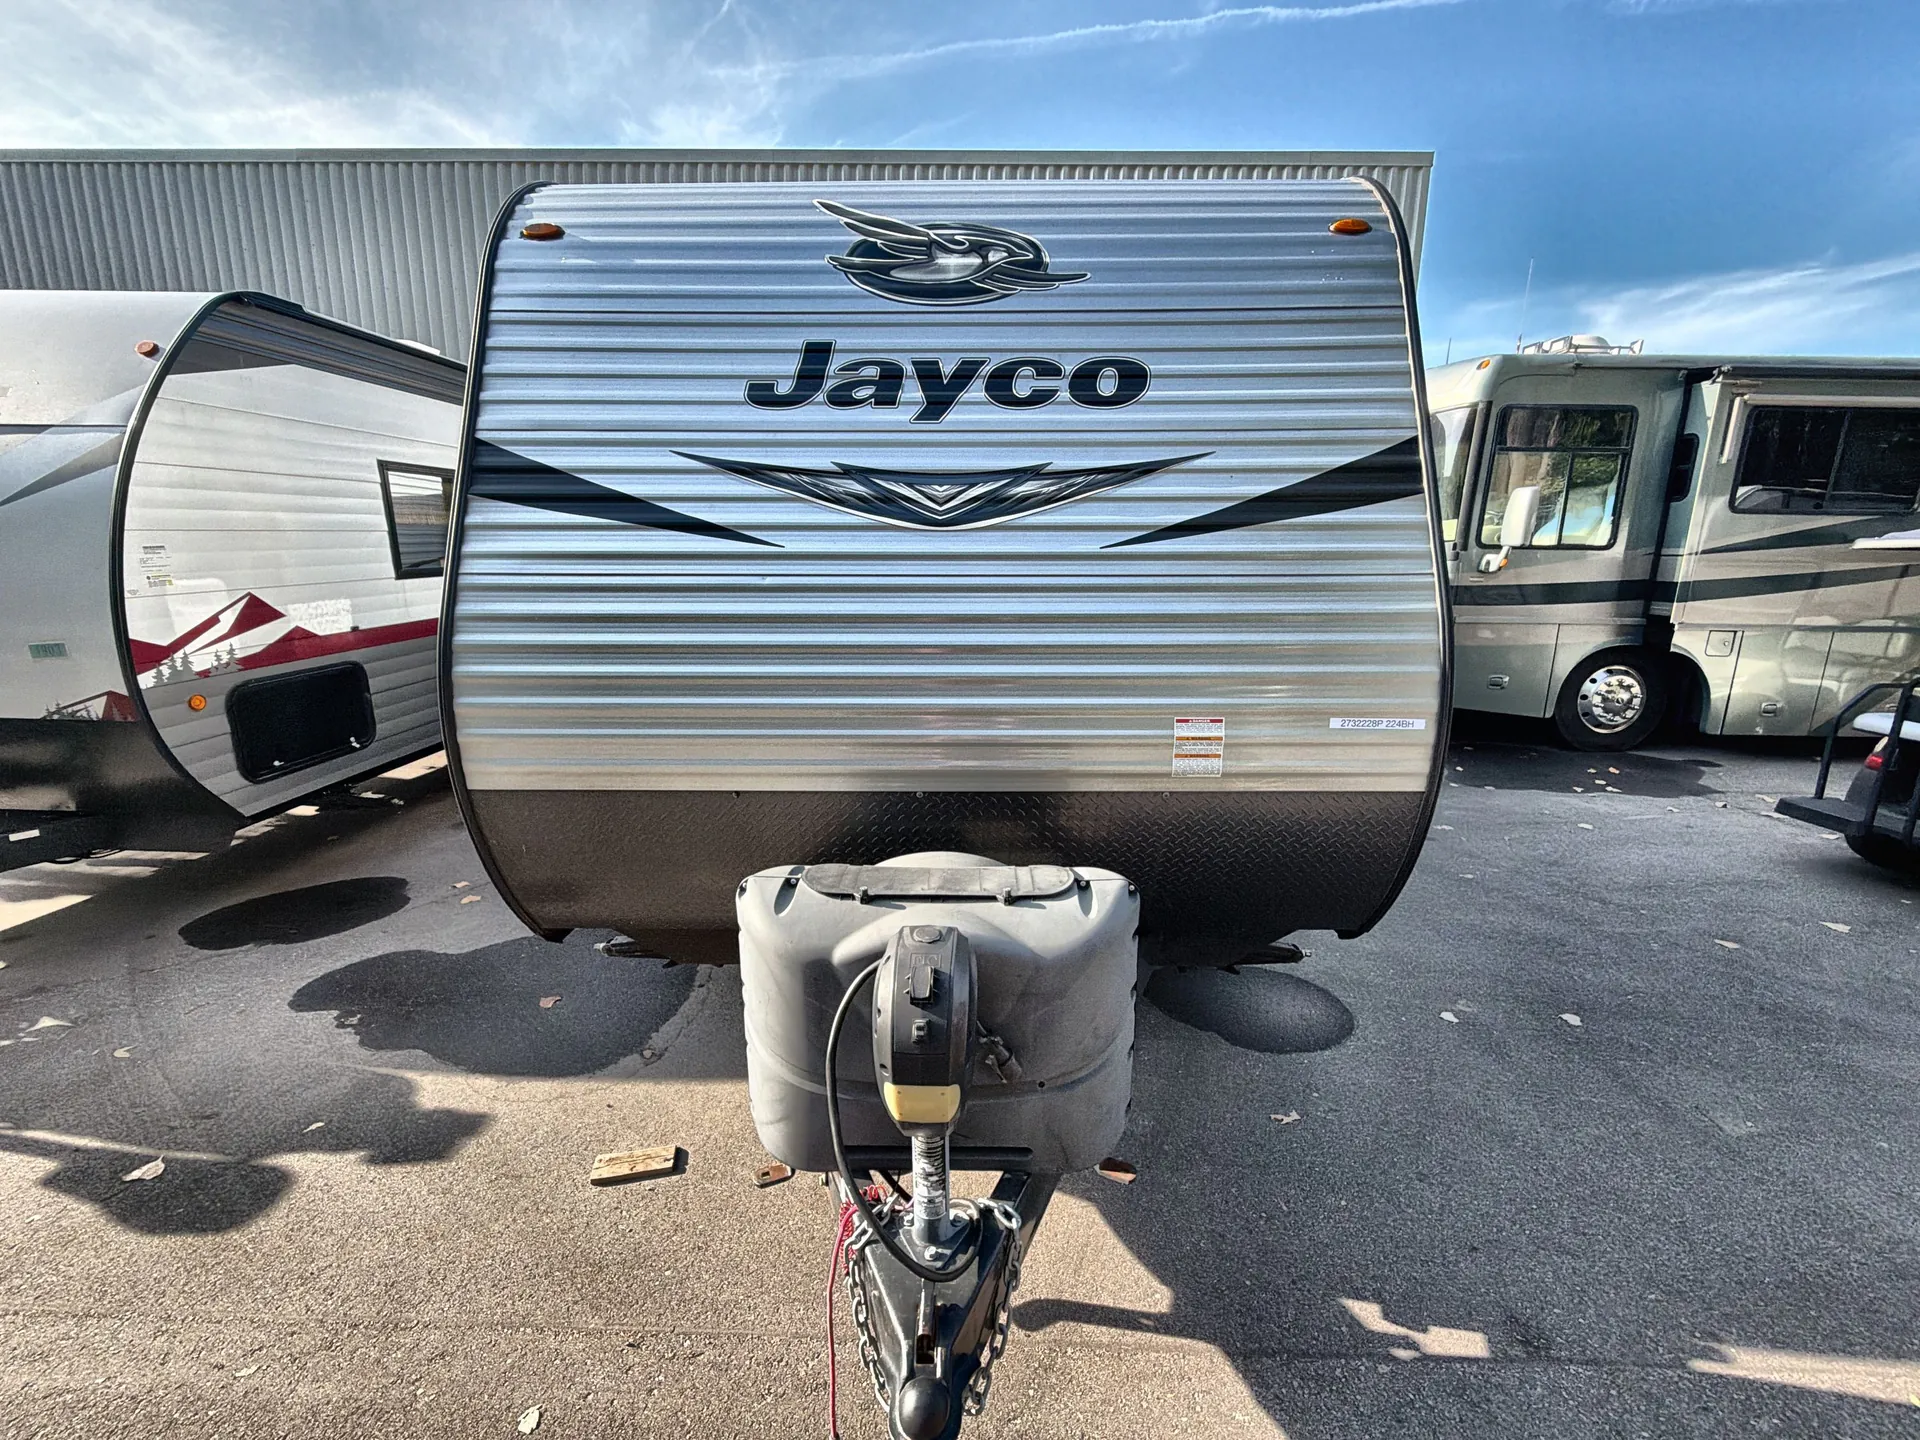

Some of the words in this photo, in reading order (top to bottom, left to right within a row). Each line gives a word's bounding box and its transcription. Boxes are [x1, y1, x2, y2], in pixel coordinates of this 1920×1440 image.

[744, 339, 1151, 424] Jayco
[1340, 718, 1384, 728] 2732228P
[1385, 719, 1415, 728] 224BH
